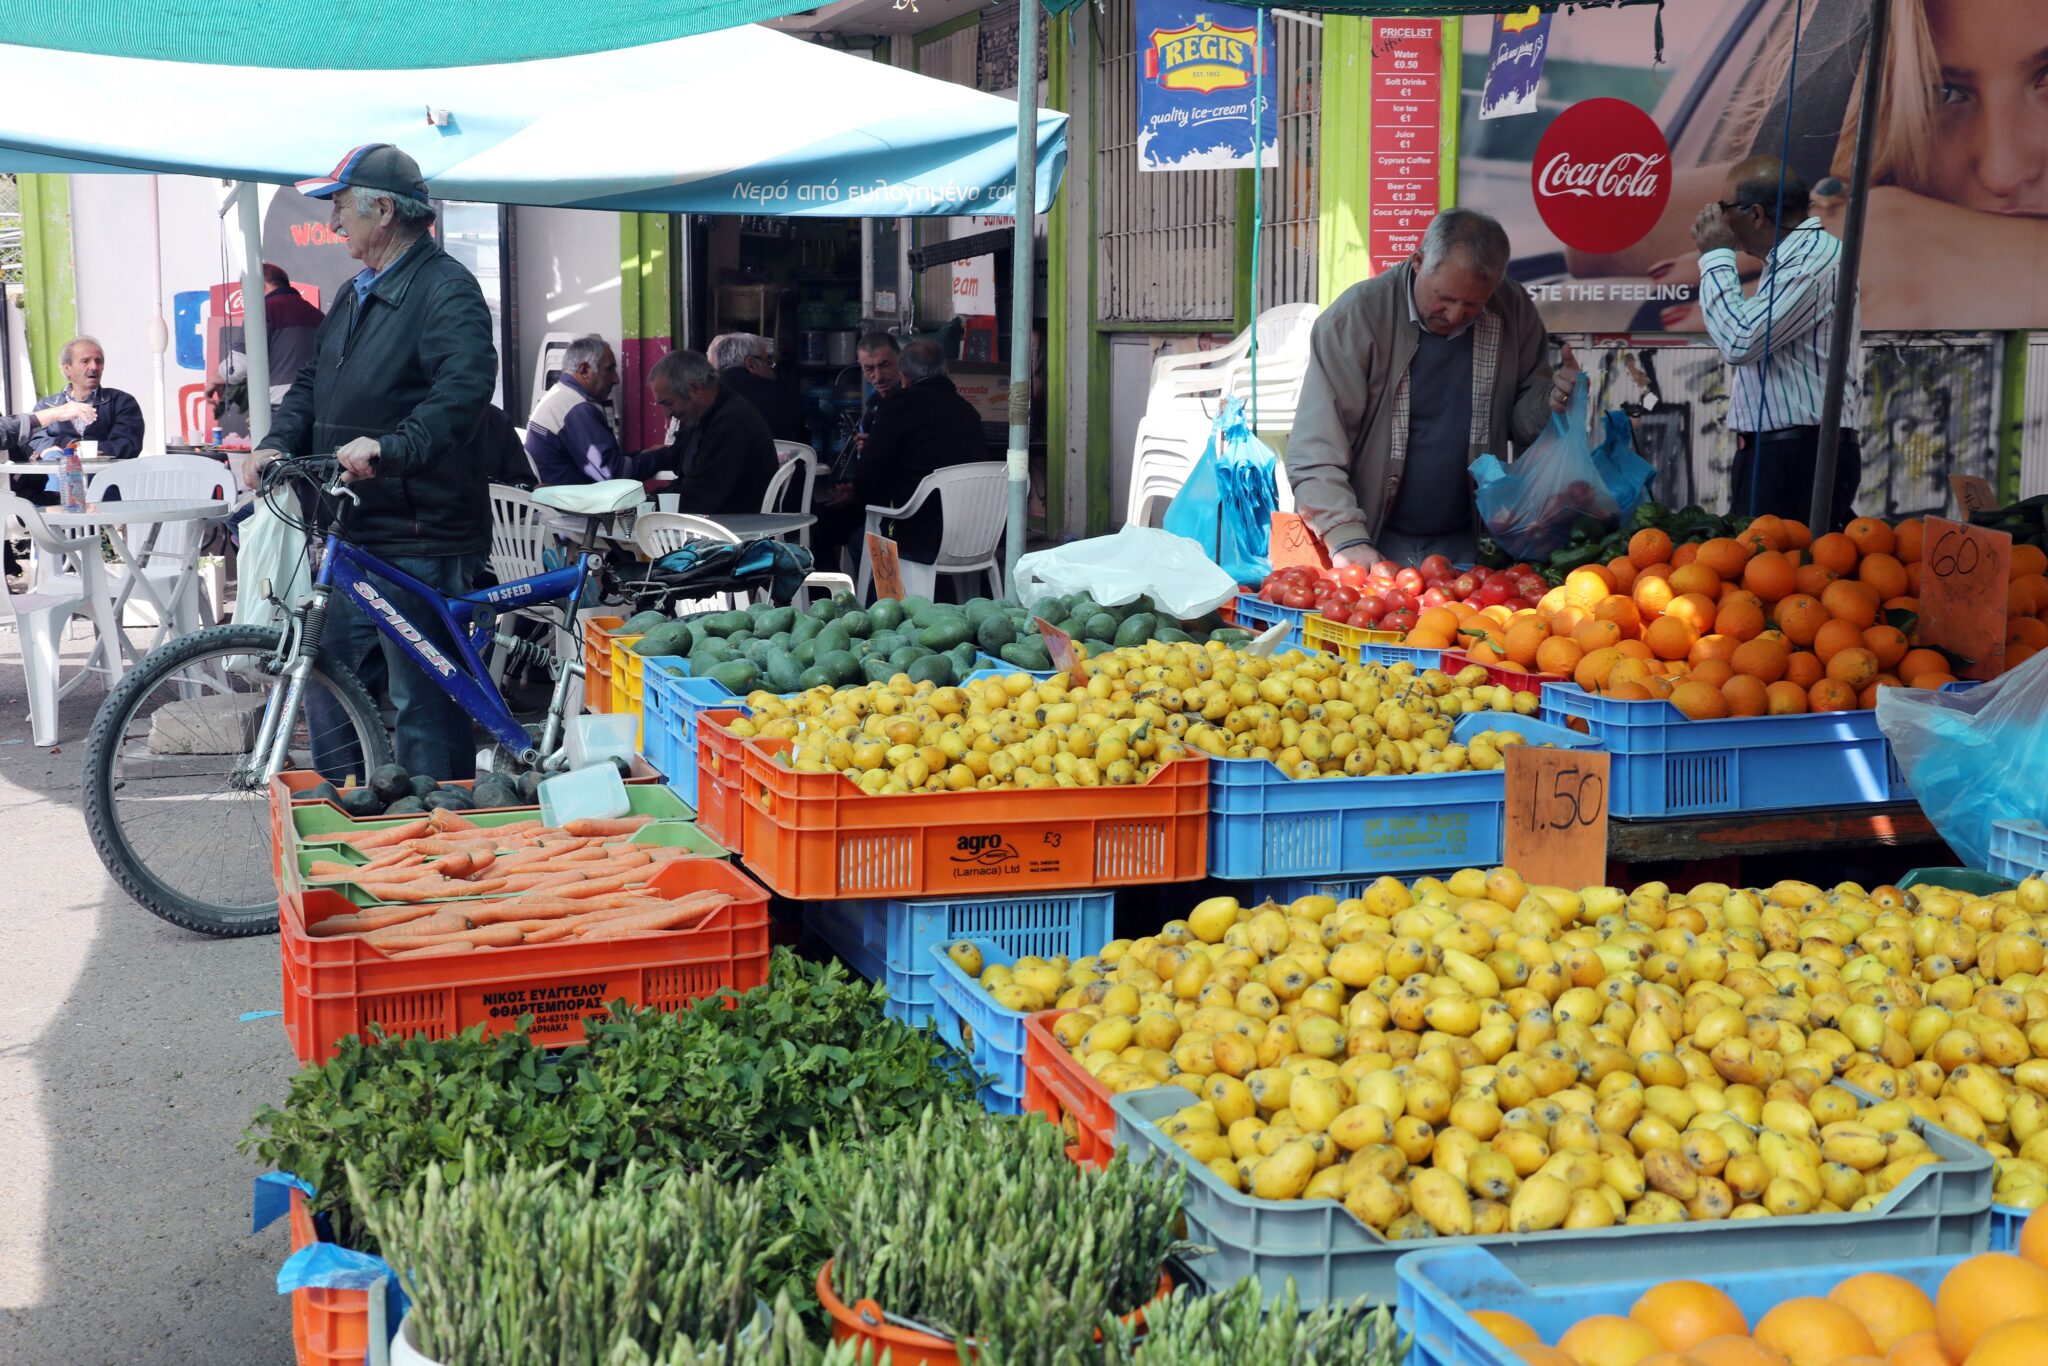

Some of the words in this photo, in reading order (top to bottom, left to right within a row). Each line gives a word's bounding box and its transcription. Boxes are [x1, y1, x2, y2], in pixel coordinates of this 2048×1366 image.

[1380, 28, 1433, 37] PRICELIST
[1166, 36, 1244, 69] REGIS
[1394, 50, 1418, 58] Water
[1394, 60, 1418, 69] €0.50
[1385, 78, 1401, 86] Soft
[1402, 78, 1427, 86] Drinks
[1400, 88, 1411, 96] €1
[1151, 107, 1189, 130] quality
[1191, 104, 1248, 119] ice-cream
[1400, 114, 1411, 122] €1
[1400, 140, 1410, 148] €1
[1378, 157, 1405, 165] Cyprus
[1399, 167, 1410, 175] €1
[1538, 152, 1666, 197] Coca-Cola
[732, 179, 789, 206] Νερό
[796, 178, 839, 201] από
[848, 179, 980, 207] ευλογημένο
[1392, 193, 1416, 201] €1.20
[1373, 208, 1392, 216] Coca
[1414, 208, 1435, 217] Pepsi
[1398, 218, 1409, 226] €1
[1388, 234, 1418, 242] Nescafe
[1391, 244, 1416, 252] €1.50
[1567, 284, 1604, 301] THE
[1609, 283, 1690, 301] FEELING
[1932, 531, 1979, 577] 60
[353, 581, 457, 678] SPIDER
[1531, 769, 1603, 833] 1.50
[957, 834, 1002, 855] agro
[1043, 831, 1062, 848] £3
[953, 866, 1002, 878] (Larnaca)
[1004, 864, 1020, 874] Ltd
[483, 990, 526, 1006] ΝΙΚΟΣ
[530, 983, 608, 1001] ΕΥΑΓΓΕΛΟΥ
[489, 997, 603, 1018] ΦΘΑΡΤΕΜΠΟΡΑΣ
[536, 1012, 580, 1024] 04-631916
